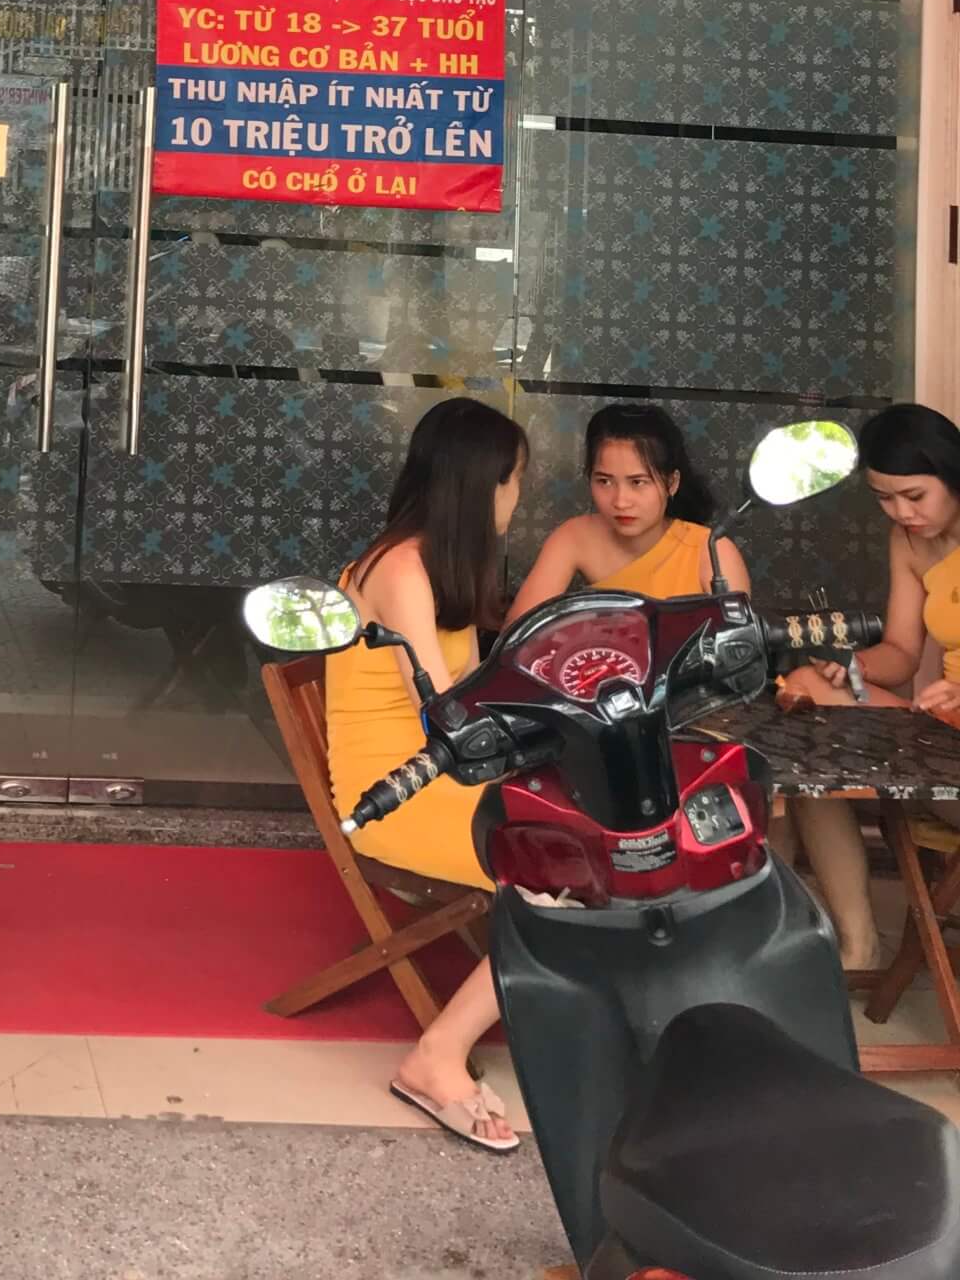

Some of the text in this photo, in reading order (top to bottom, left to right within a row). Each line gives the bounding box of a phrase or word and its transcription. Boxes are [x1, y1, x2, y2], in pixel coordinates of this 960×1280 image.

[177, 7, 224, 30] YC:
[234, 4, 276, 32] TỪ
[286, 12, 322, 33] 18
[371, 15, 408, 37] 37
[417, 8, 484, 41] TUỔI
[183, 39, 479, 75] LƯƠNG CƠ BẢN + HH
[167, 77, 494, 113] THU NHẬP ÍT NHẤT TỪ
[170, 113, 493, 158] 10 TRIỆU TRỞ LÊN
[242, 166, 277, 189] CÓ
[347, 167, 368, 193] Ở
[375, 175, 417, 199] LẠI
